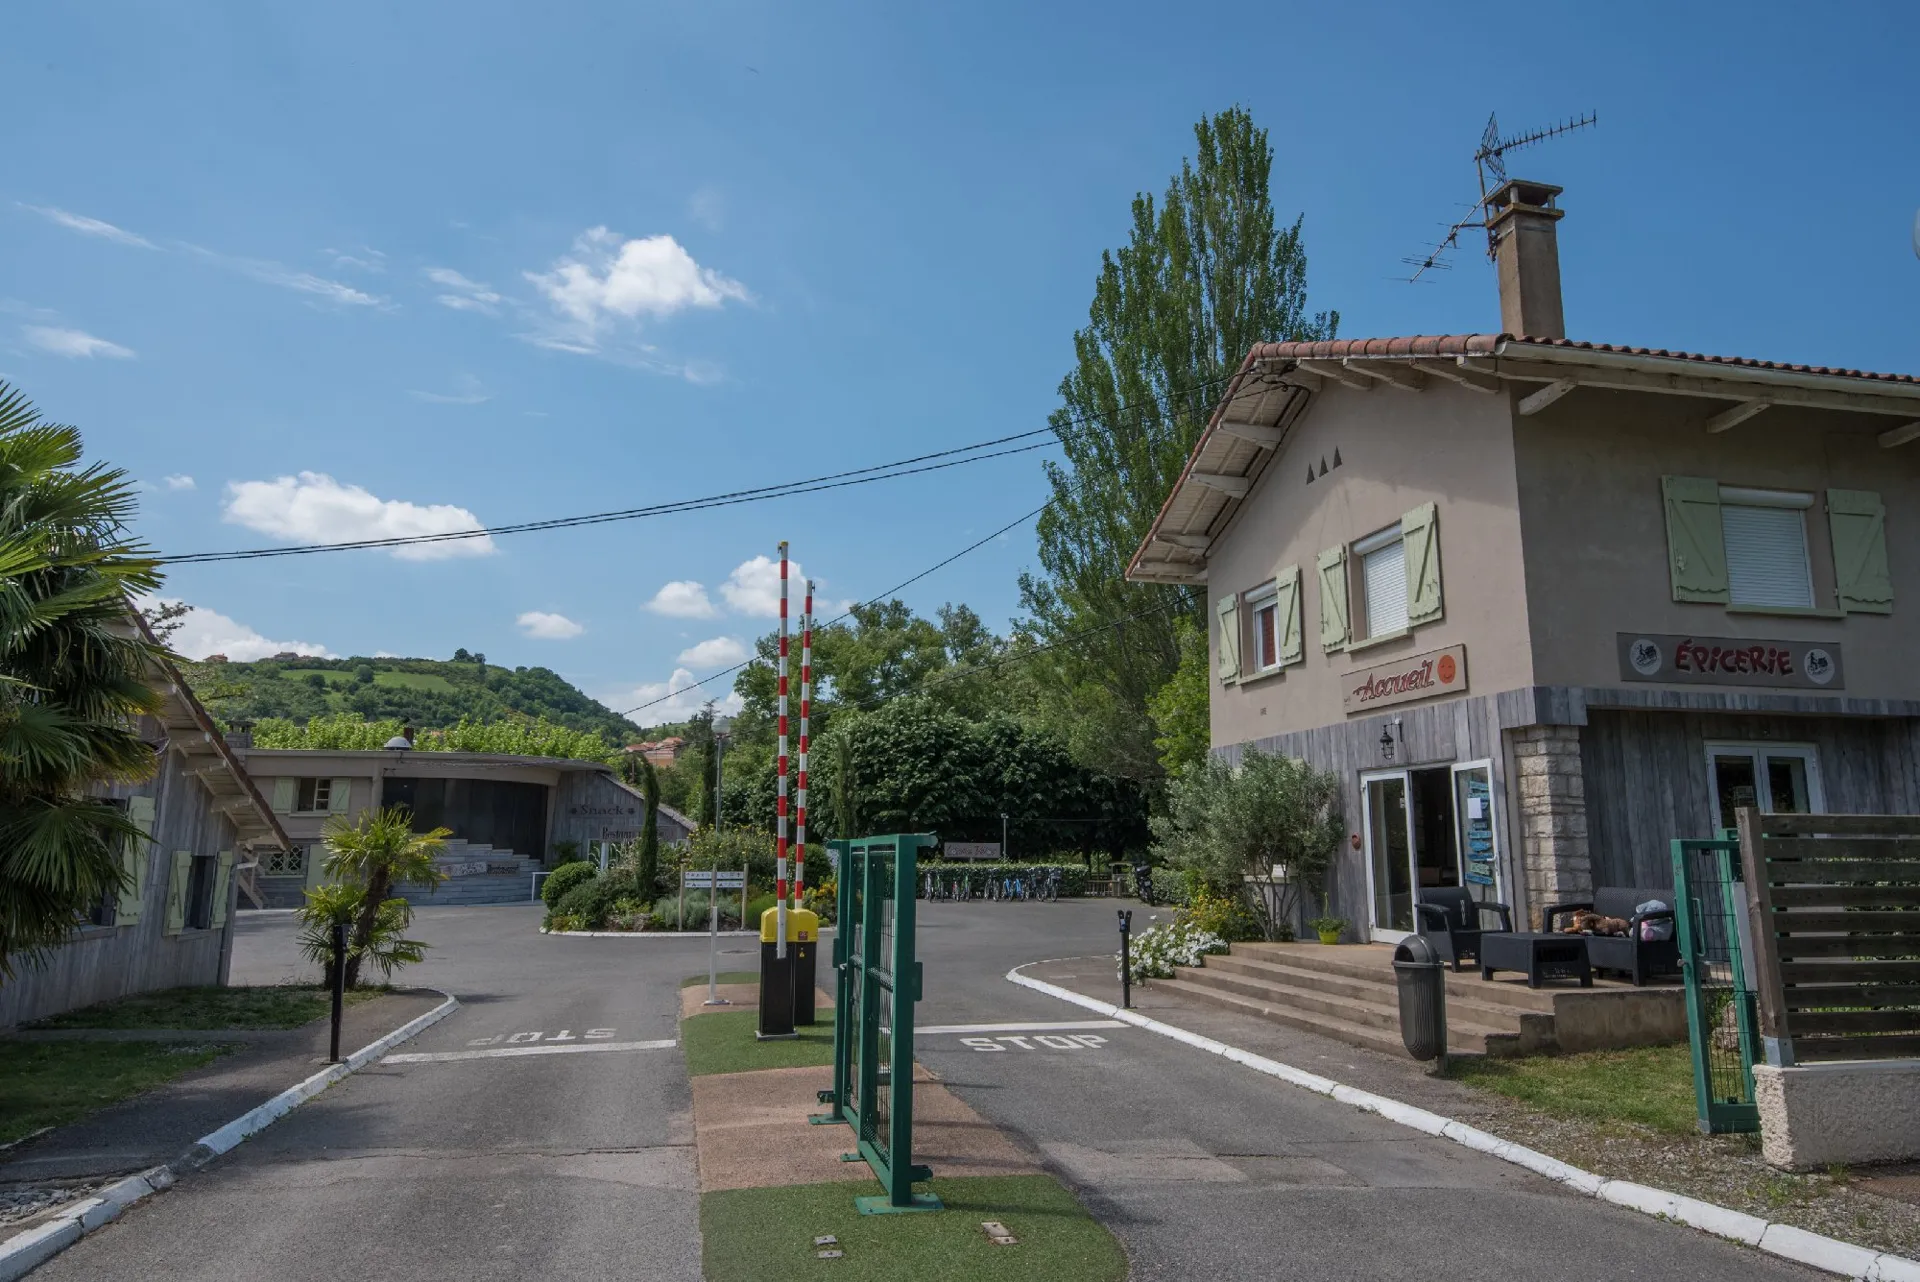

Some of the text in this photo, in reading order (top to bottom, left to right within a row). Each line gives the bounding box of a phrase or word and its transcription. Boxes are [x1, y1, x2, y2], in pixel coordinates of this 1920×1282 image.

[1353, 660, 1434, 702] Accueil
[580, 804, 624, 816] Snack
[466, 1028, 617, 1046] STOP
[960, 1034, 1108, 1052] STOP
